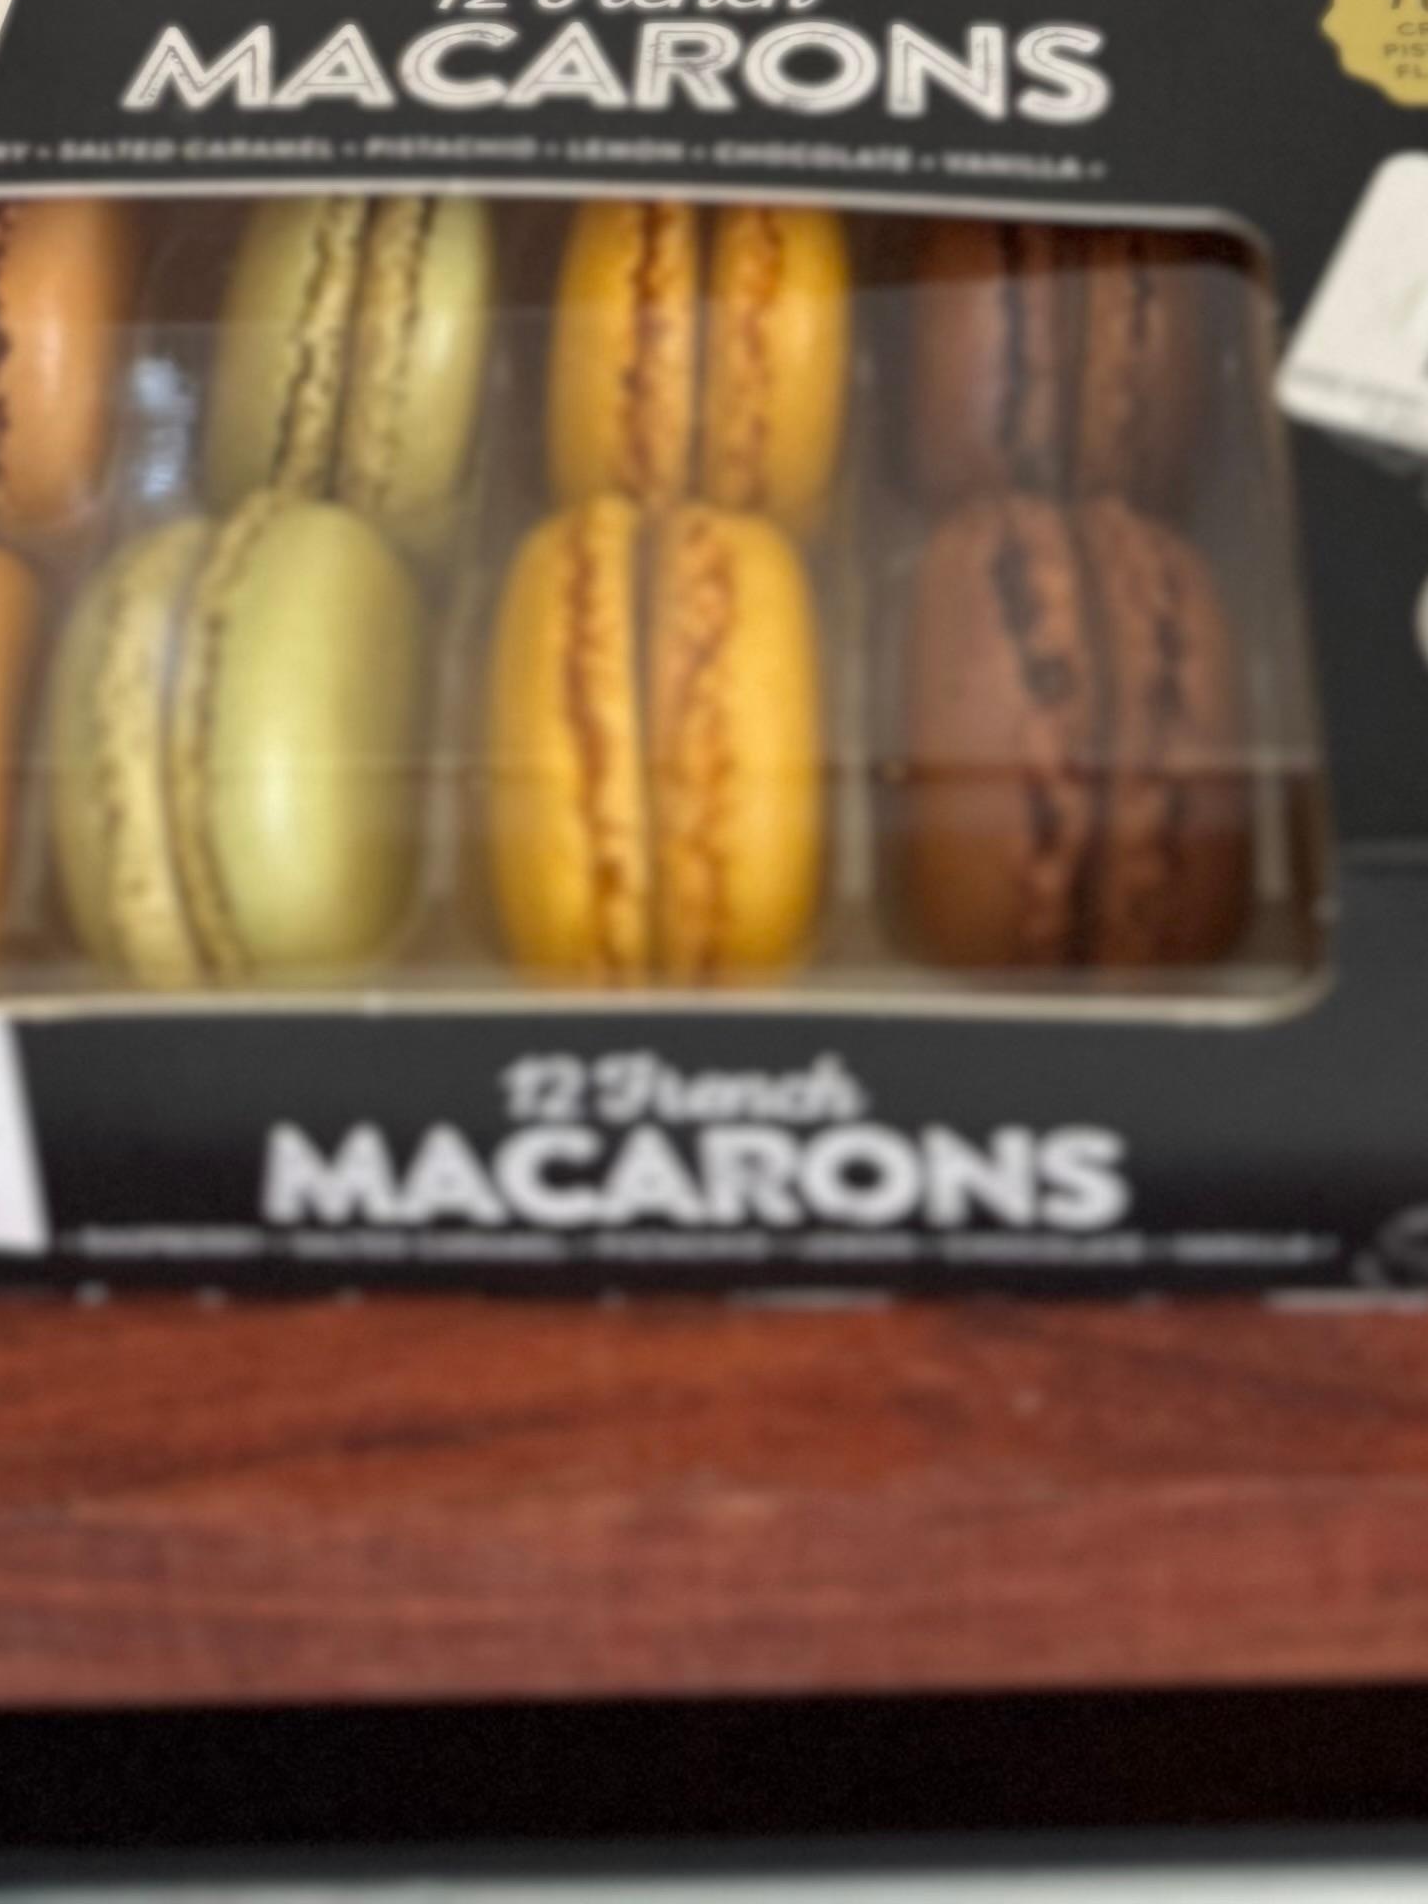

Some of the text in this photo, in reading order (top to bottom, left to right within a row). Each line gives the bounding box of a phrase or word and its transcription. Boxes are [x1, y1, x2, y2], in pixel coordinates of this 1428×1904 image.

[122, 21, 1110, 122] MACARONS
[59, 138, 170, 163] SALTED
[184, 138, 333, 163] CARAMEL
[504, 1051, 865, 1124] 12 French
[264, 1122, 1129, 1231] MACARONS
